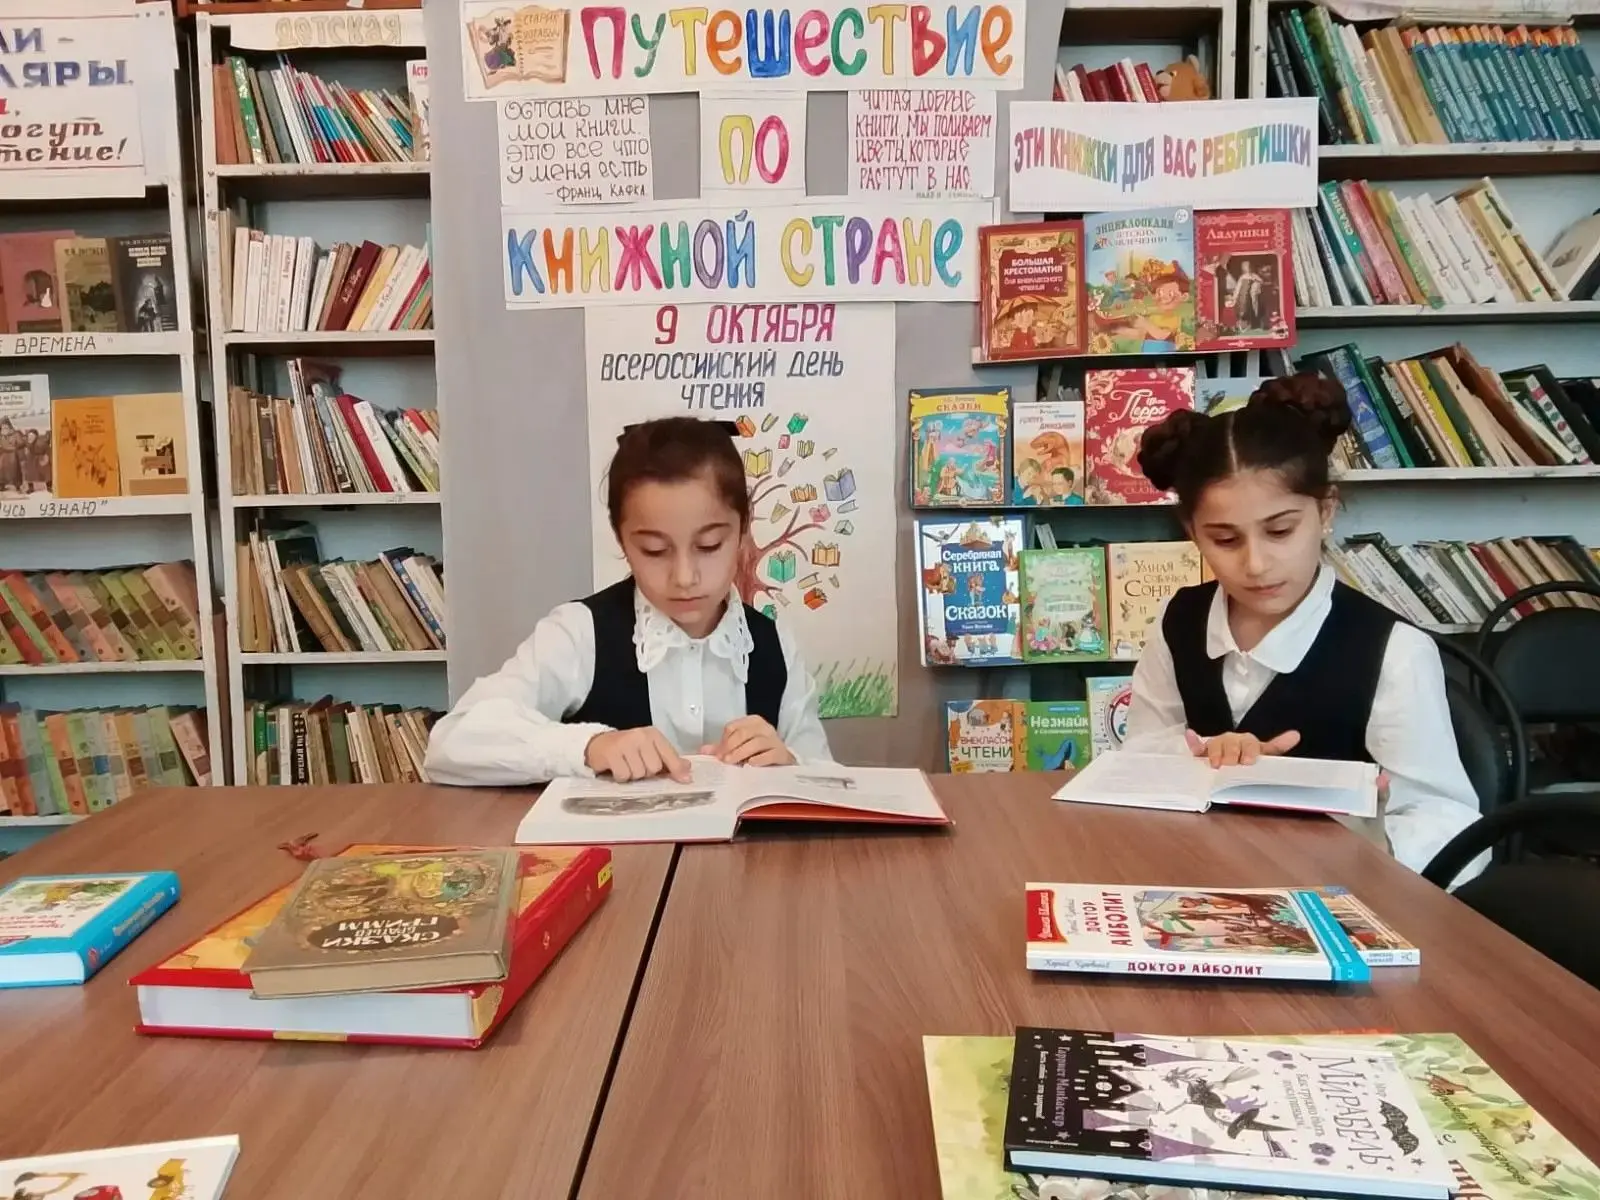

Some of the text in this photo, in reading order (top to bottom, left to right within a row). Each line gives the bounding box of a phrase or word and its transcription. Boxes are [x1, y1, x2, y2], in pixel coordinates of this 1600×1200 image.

[580, 4, 1013, 80] ПУТЕШЕСТВИЕ
[719, 113, 791, 186] ПО
[1013, 122, 1313, 193] ЭТИ КНИЖКИ ДЛЯ ВАС РЕБЯТИШКИ
[506, 208, 964, 296] КНИЖНОЙ СТРАНЕ
[1011, 256, 1055, 267] БОЛЬШАЯ
[1003, 265, 1064, 277] ХРЕСТОМАТИЯ
[655, 303, 837, 345] 9 ОКТЯБРЯ
[0, 500, 27, 518] УСЬ
[953, 560, 1001, 574] книга
[945, 605, 1008, 621] Сказок
[338, 914, 440, 931] ГРИММ
[1083, 900, 1100, 933] ДОКТОР
[1101, 891, 1133, 947] АЙБОЛИТ
[321, 930, 441, 948] СКАЗКИ
[1127, 961, 1264, 976] ДОКТОР АЙБОЛИТ
